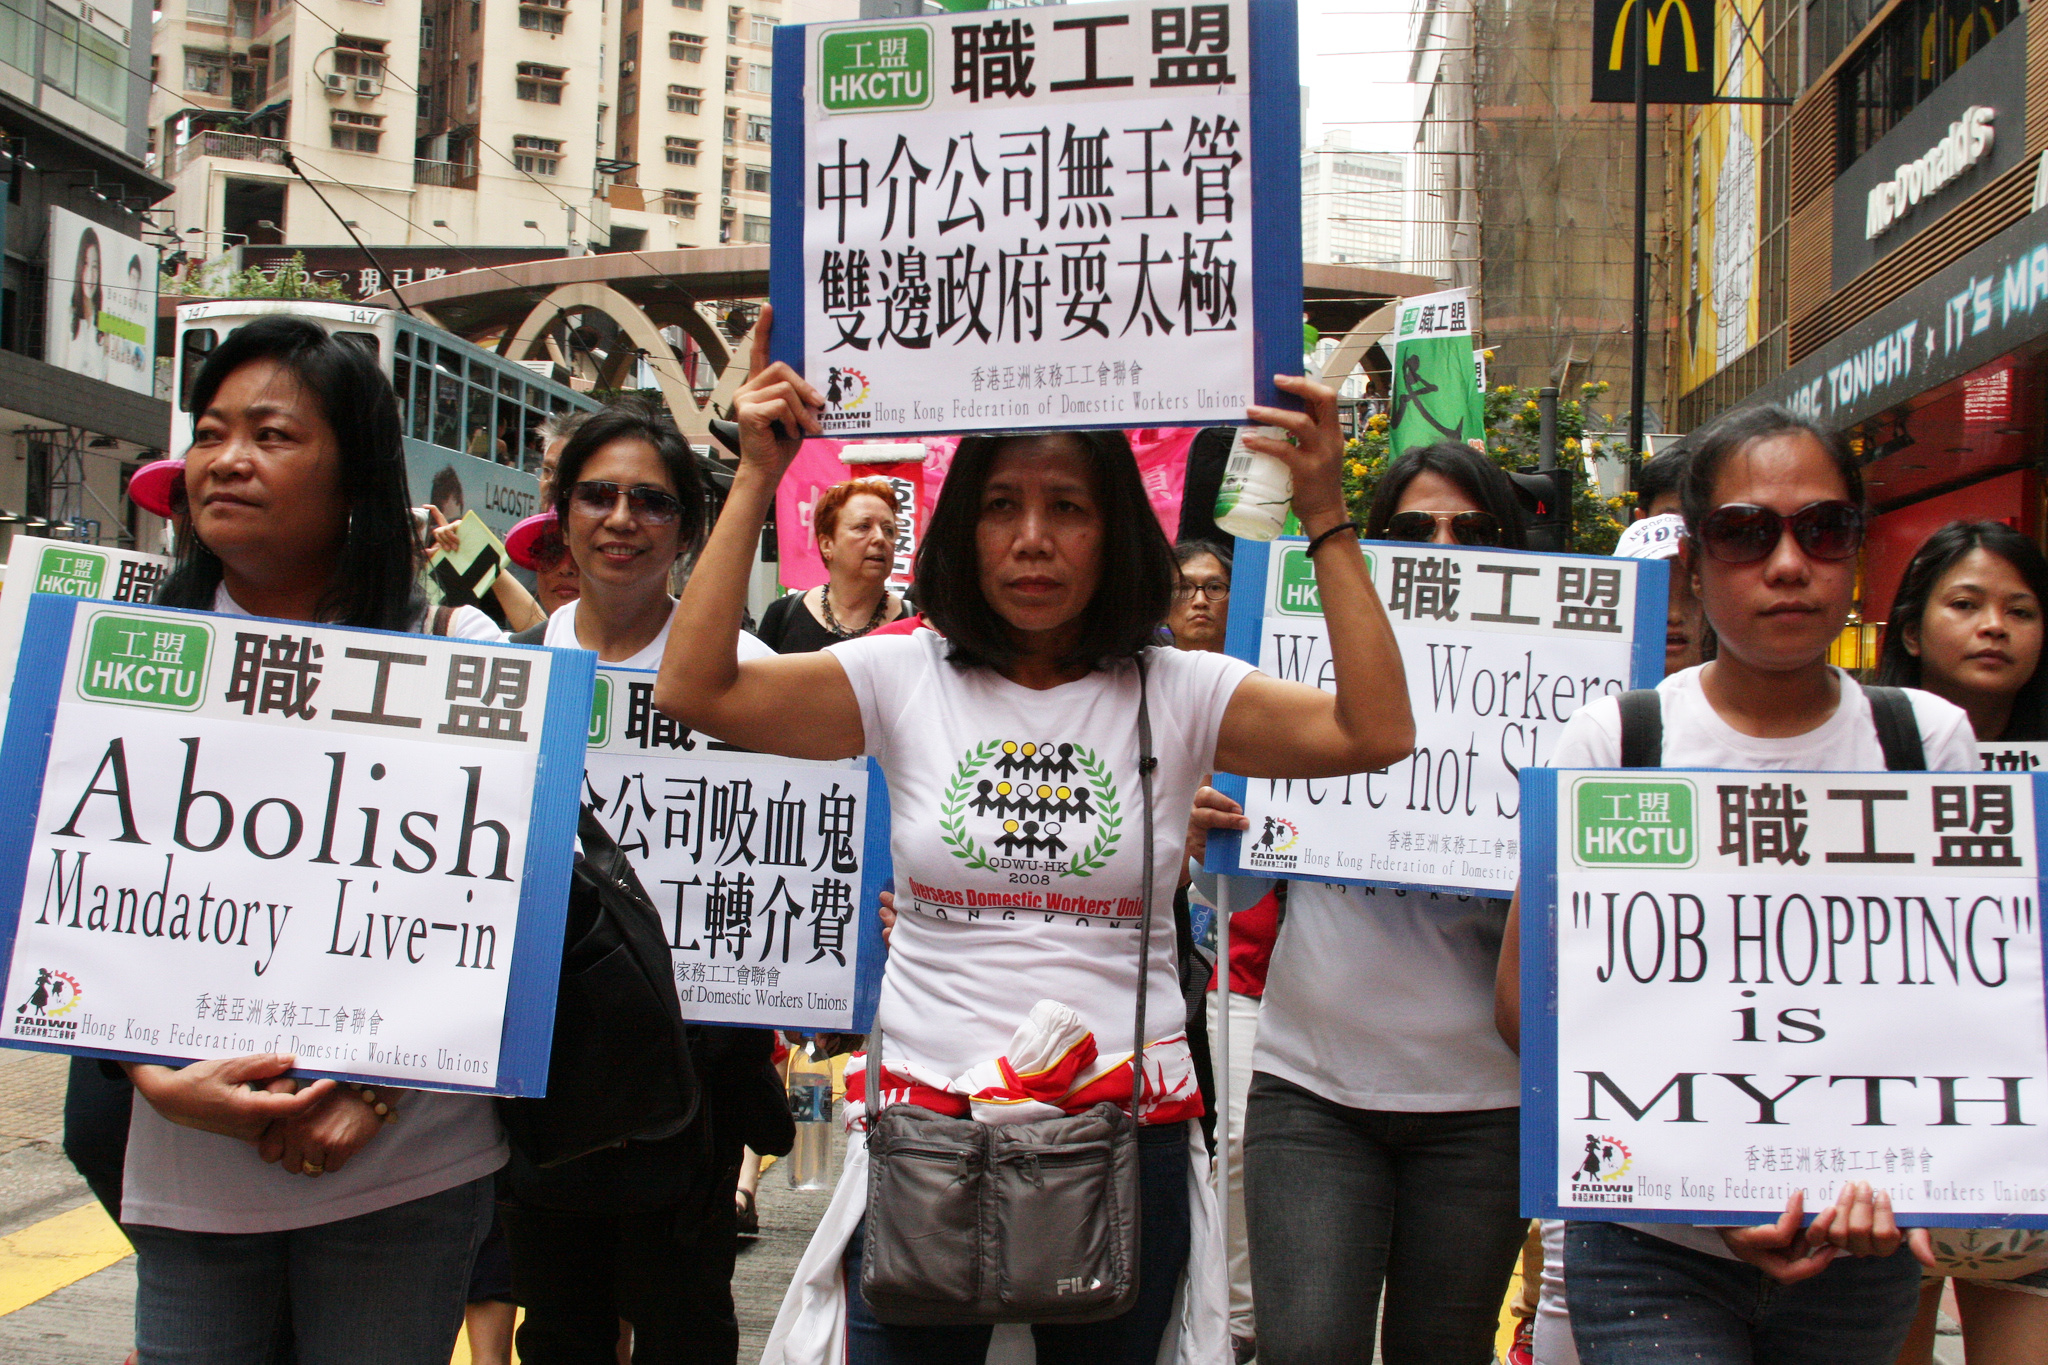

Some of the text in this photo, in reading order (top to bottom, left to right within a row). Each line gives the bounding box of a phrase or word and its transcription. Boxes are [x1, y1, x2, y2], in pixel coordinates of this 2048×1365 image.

[843, 37, 909, 71] 工盟
[950, 4, 1237, 103] 職工盟
[829, 70, 924, 102] HKCTU
[817, 115, 1243, 245] 中介公司無王管
[819, 229, 1239, 354] 雙邊政府耍太極
[188, 305, 210, 320] 147
[350, 309, 377, 324] 147
[1418, 302, 1467, 334] 職工盟
[1827, 319, 1919, 417] TONIGHT
[1945, 274, 1995, 358] IT'S
[971, 359, 1144, 392] 香港亞洲家務工工會聯會
[816, 411, 872, 420] FADWU
[874, 388, 1246, 424] Hong Kong Federation of Domestic Workers Unions
[484, 482, 536, 518] LACOSTE
[52, 556, 95, 579] 工盟
[39, 574, 98, 599] HKCTU
[1388, 556, 1623, 634] 職工盟
[112, 630, 187, 665] 工盟
[91, 660, 196, 698] HKCTU
[225, 631, 531, 744] 職工盟
[1405, 731, 1480, 817] not
[50, 735, 515, 883] Abolish
[1599, 792, 1672, 823] 工盟
[1716, 783, 2023, 867] 職工盟
[1250, 852, 1298, 861] FADWU
[1584, 826, 1687, 856] HKCTU
[989, 856, 1070, 873] ODWU-HK
[1009, 873, 1051, 886] 2008
[1303, 848, 1515, 880] Hong Kong Federation of Domestic
[35, 848, 497, 977] Mandatory Live-in
[908, 875, 965, 906] Overseas
[966, 888, 1042, 909] Domestic
[1046, 892, 1117, 916] Workers'
[660, 871, 855, 968] 工轉介費
[1572, 890, 2033, 988] "JOB HOPPING"
[195, 992, 385, 1036] 香港亞洲家務工工會聯會
[681, 986, 848, 1011] of Domestic Workers Unions
[1731, 989, 1826, 1043] is
[15, 1016, 78, 1030] FADWU
[81, 1013, 489, 1074] Hong Kong Federation of Domestic Workers Unions
[1573, 1070, 2038, 1127] MYTH
[1745, 1145, 1934, 1174] 香港亞洲家務工工會聯會
[1571, 1183, 1634, 1194] FADWU
[1637, 1175, 1673, 1201] Hong
[1680, 1176, 1716, 1202] Kong
[1819, 1179, 1836, 1201] of
[1922, 1180, 1985, 1202] Workers
[1993, 1180, 2047, 1202] Unions
